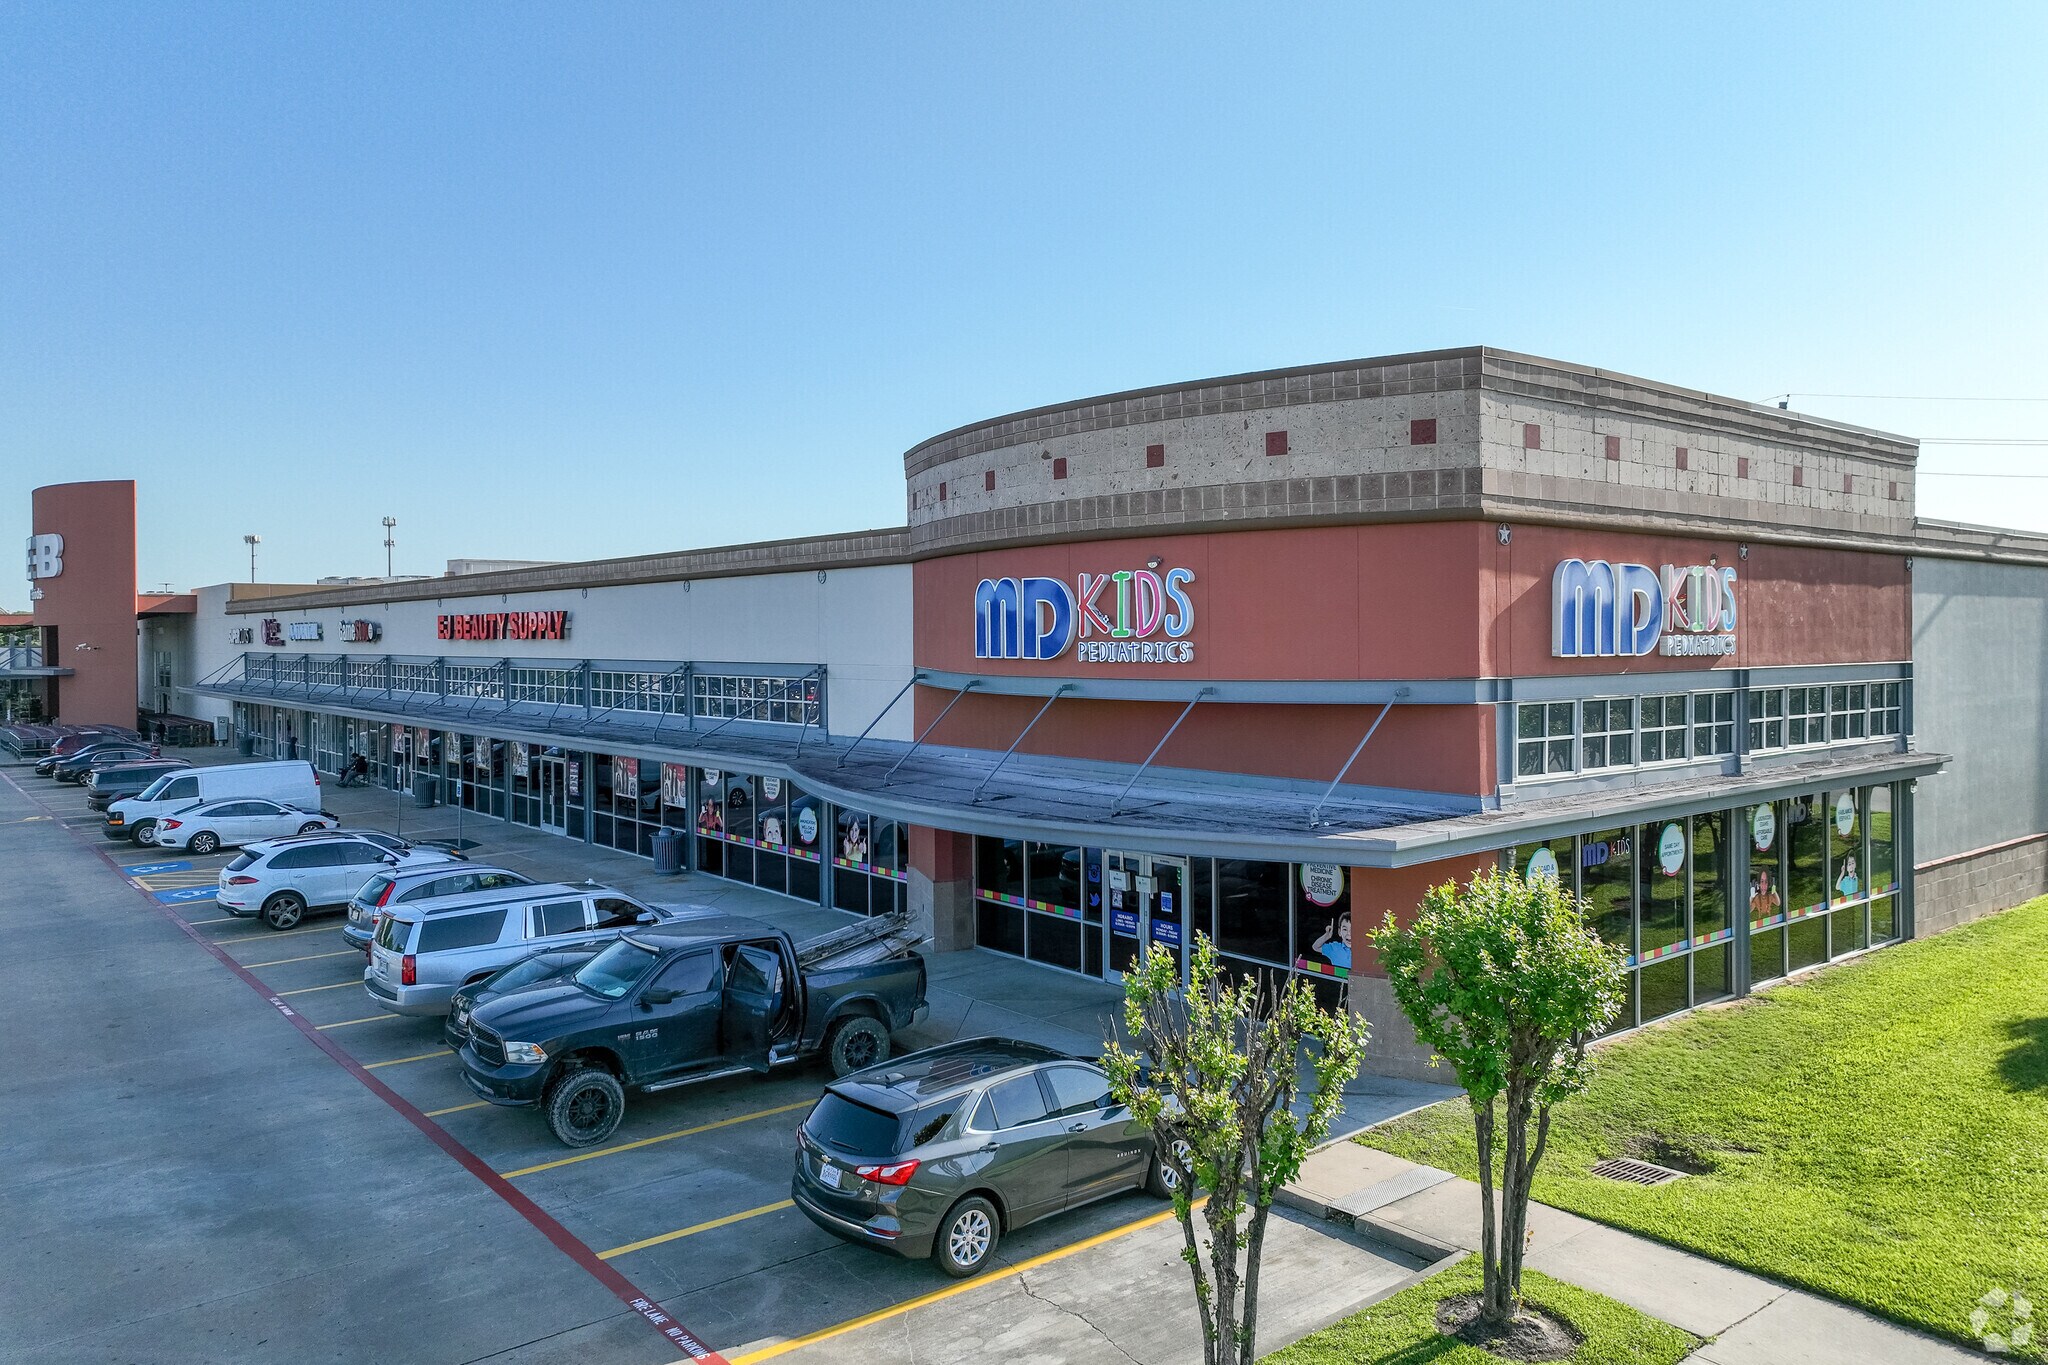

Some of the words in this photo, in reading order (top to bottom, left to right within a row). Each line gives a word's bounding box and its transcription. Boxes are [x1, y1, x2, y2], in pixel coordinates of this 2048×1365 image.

[975, 577, 1074, 660] MD
[1078, 567, 1195, 638] KIDS
[1555, 558, 1663, 657] MD
[1664, 564, 1737, 632] KIDS
[438, 615, 452, 640] EJ
[455, 613, 508, 640] BEAUTY
[509, 611, 567, 640] SUPPLY
[1078, 641, 1194, 662] PEDIATRICS
[1664, 634, 1736, 656] PEDIATRICS
[1583, 841, 1609, 866] MD
[1610, 838, 1631, 857] KIDS
[1309, 867, 1333, 876] MEDICINE
[1310, 875, 1332, 884] CHRONIC
[1307, 886, 1337, 896] TREATMENT
[1311, 881, 1332, 890] DISEASE
[1160, 923, 1174, 931] HOURS
[644, 1308, 669, 1325] LANE
[665, 1326, 682, 1338] NO
[675, 1335, 710, 1360] PARKING
